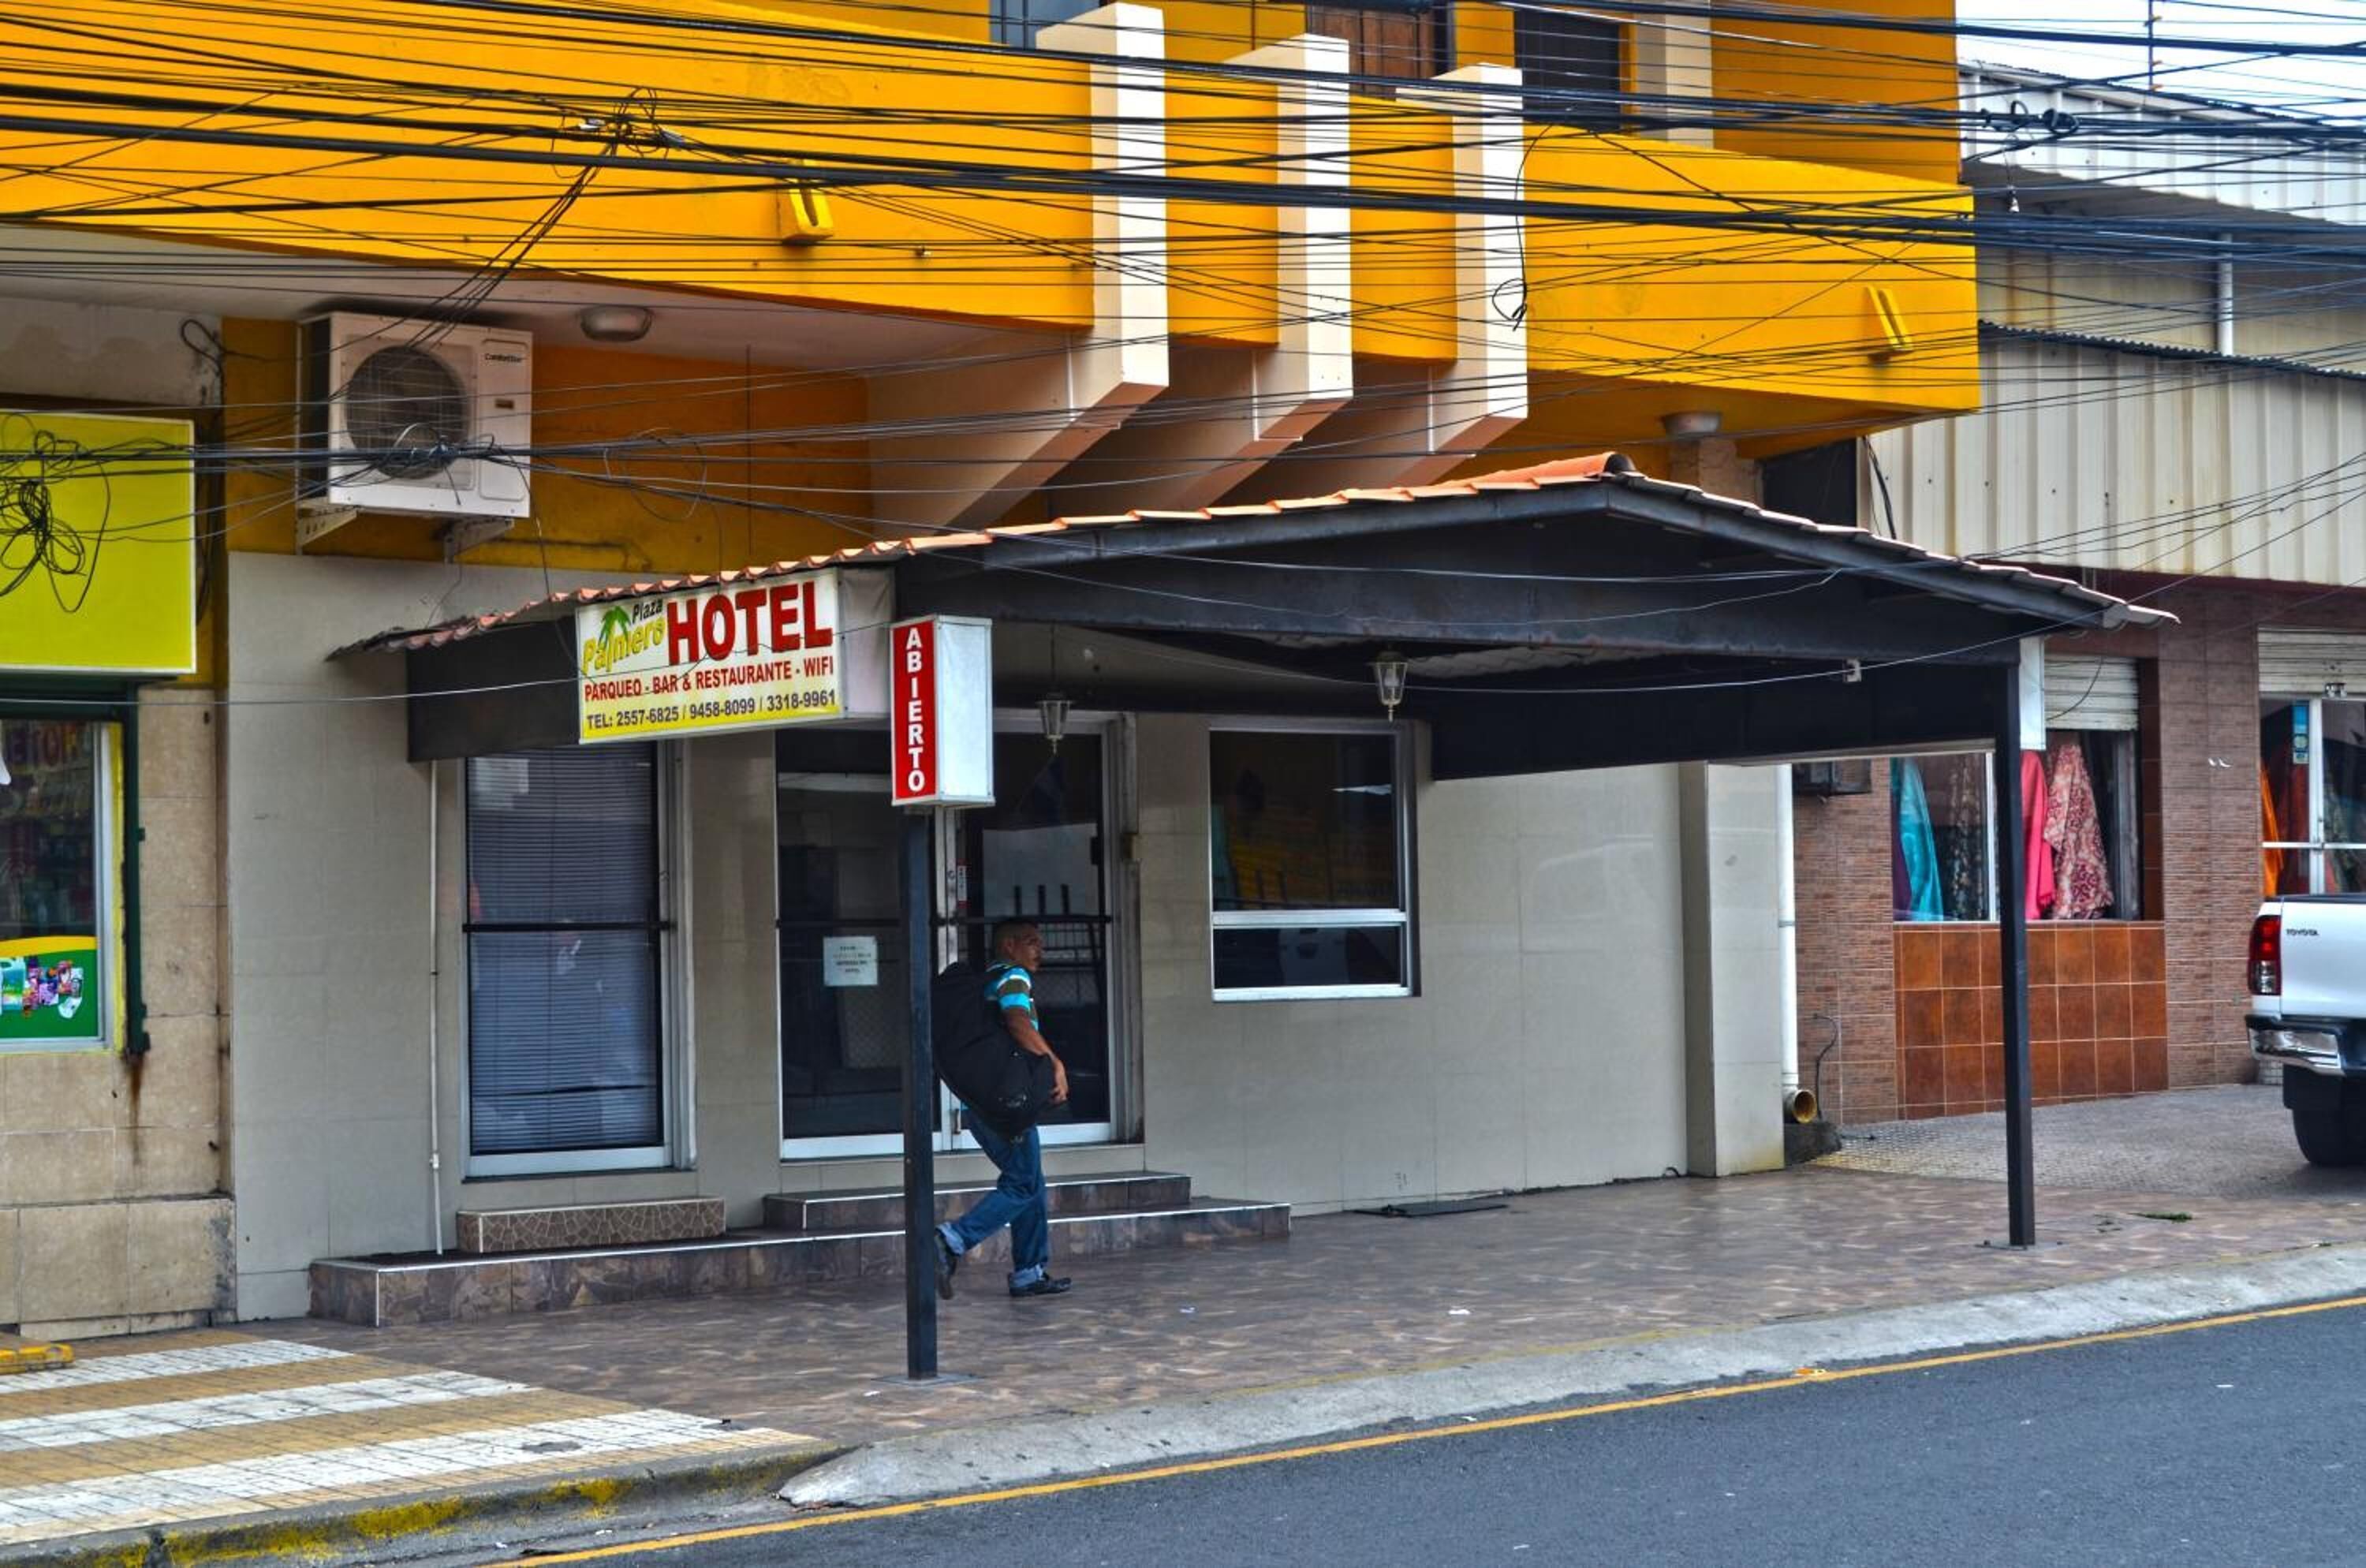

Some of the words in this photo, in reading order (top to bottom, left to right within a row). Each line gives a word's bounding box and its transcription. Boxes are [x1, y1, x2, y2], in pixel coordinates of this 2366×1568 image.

[632, 599, 663, 624] Plaza
[666, 581, 833, 666] HOTEL
[584, 678, 642, 702] PARQUEO
[652, 673, 678, 695] BAR
[682, 670, 691, 691] &
[696, 660, 792, 691] RESTAURANTE
[804, 655, 834, 678] WIFI
[586, 713, 613, 730] TEL:
[616, 705, 679, 727] 2557-6825
[689, 696, 756, 720] 9458-8099
[767, 688, 836, 712] 3318-9961
[905, 627, 925, 793] ABIERTO
